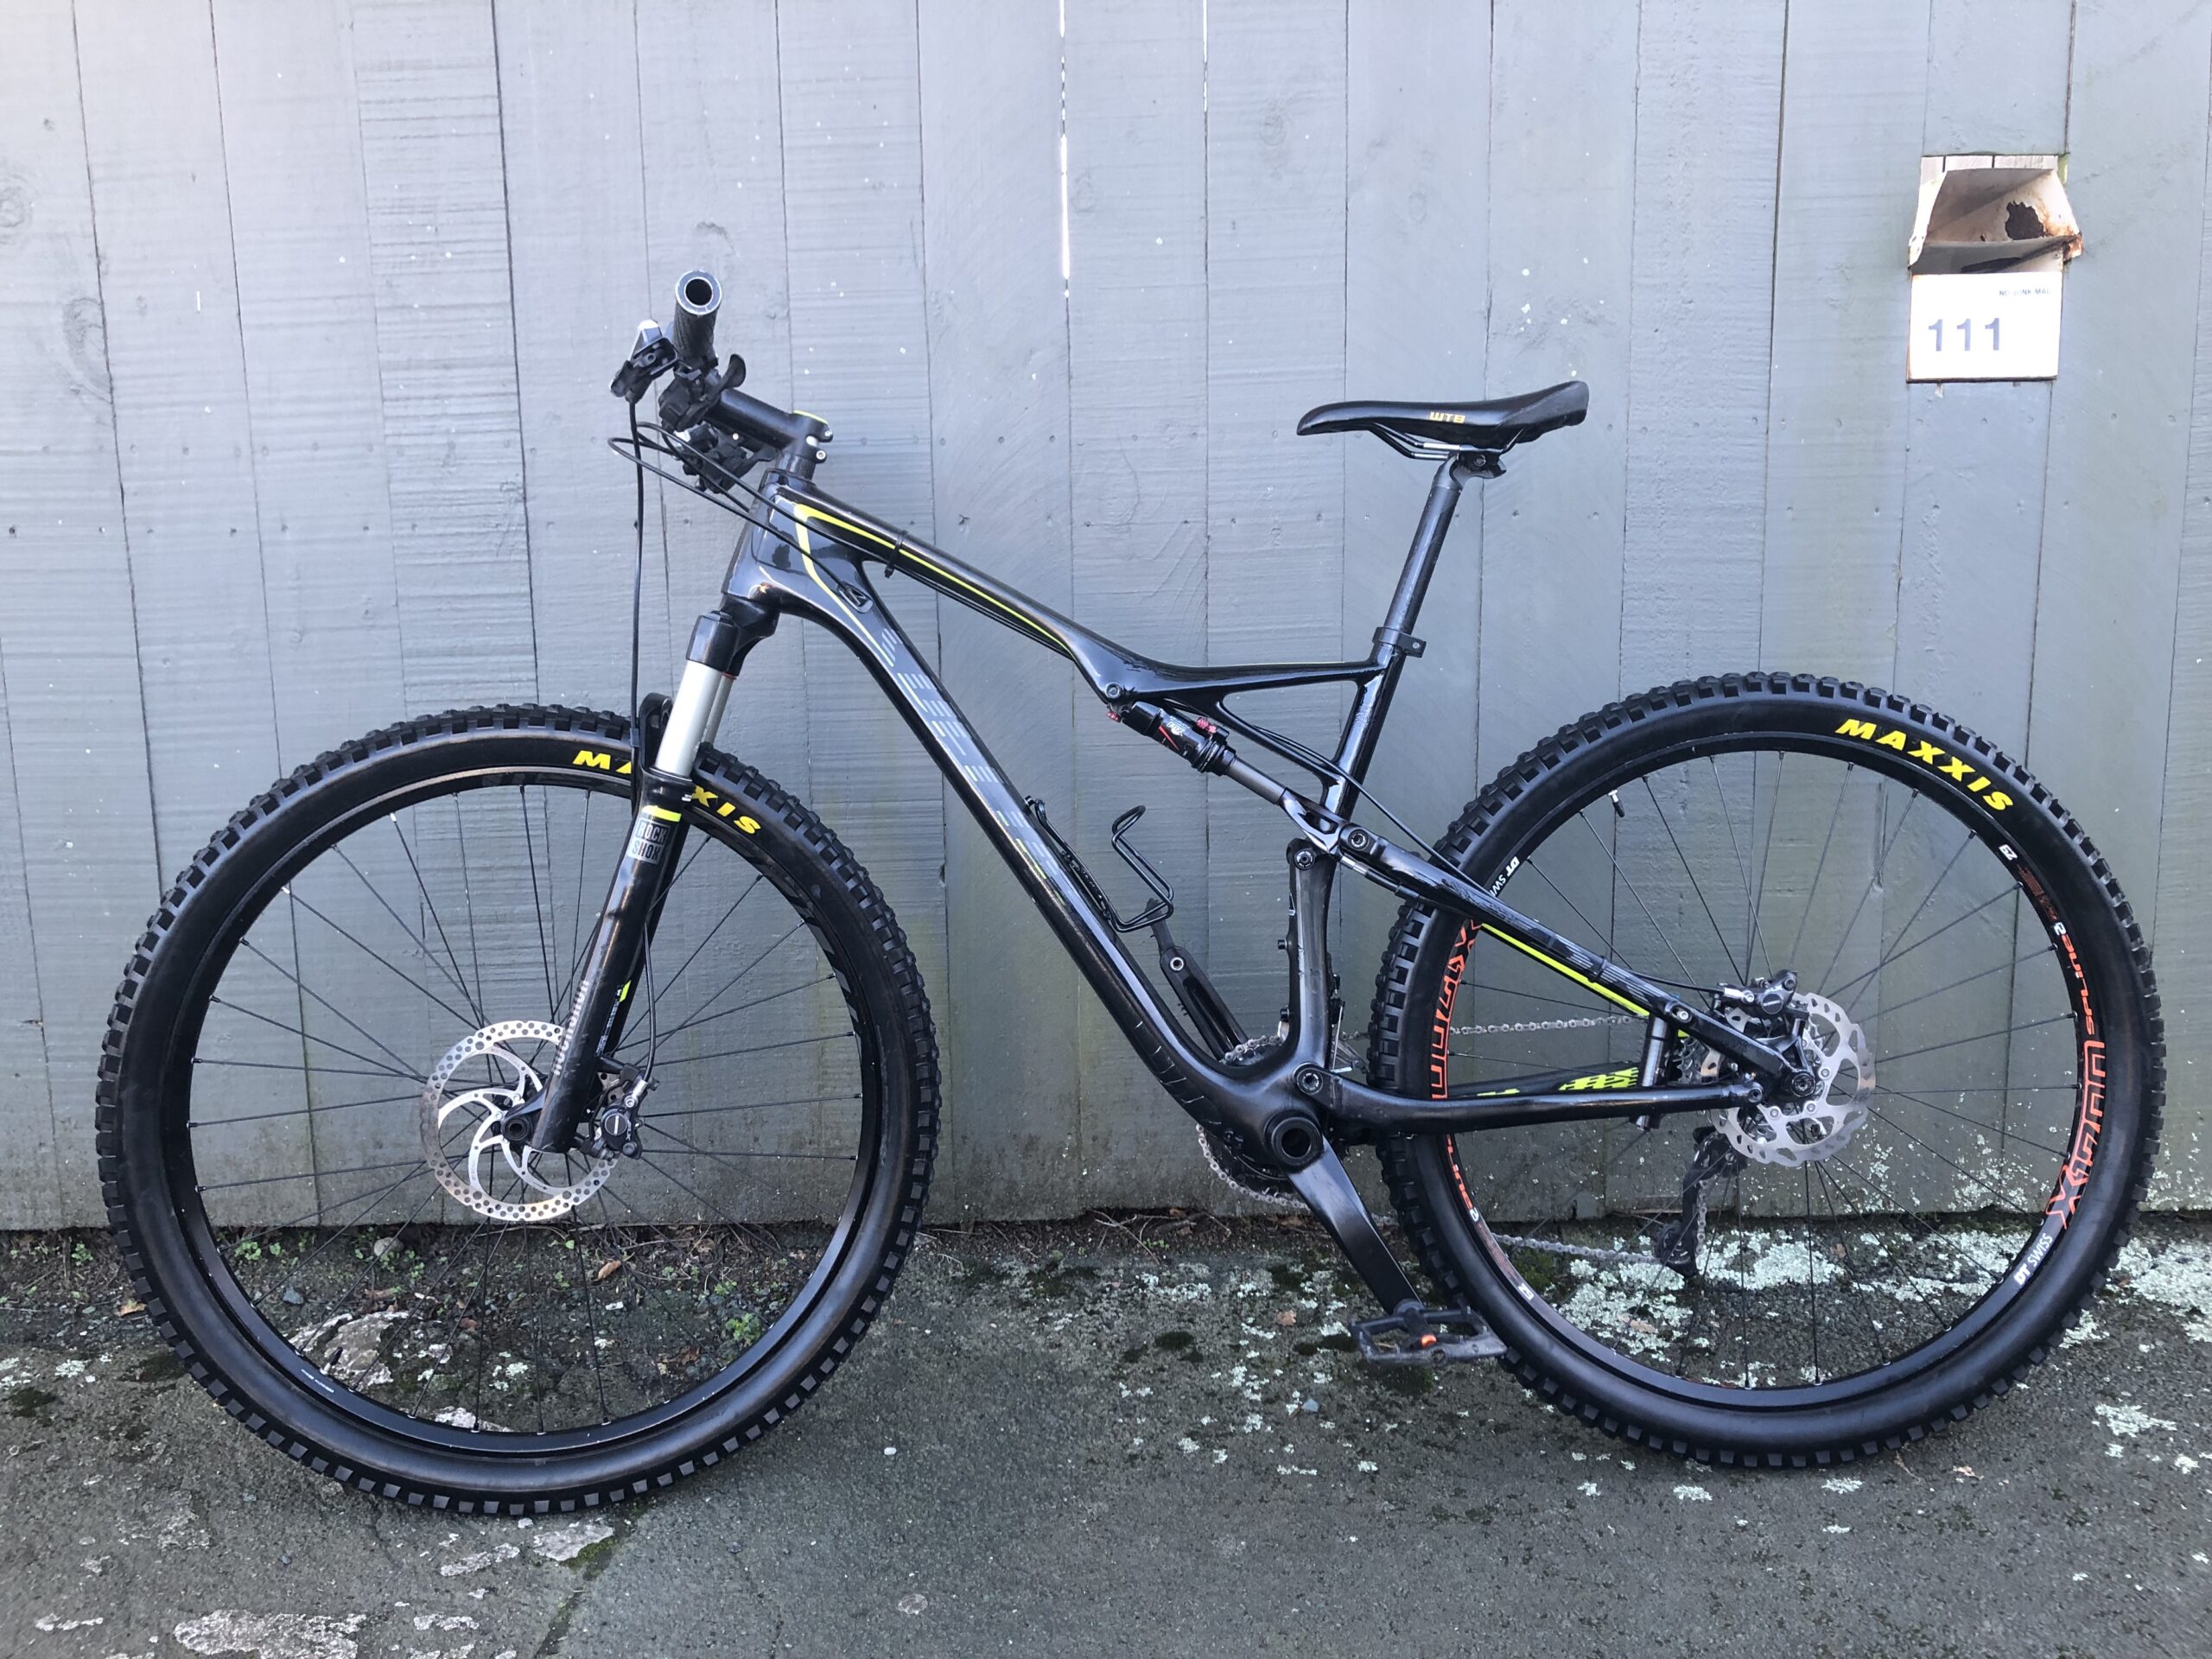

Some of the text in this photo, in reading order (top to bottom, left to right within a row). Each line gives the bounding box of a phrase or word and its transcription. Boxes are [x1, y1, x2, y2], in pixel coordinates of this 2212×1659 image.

[1928, 317, 2000, 352] 111
[1429, 411, 1466, 424] WTB
[1834, 718, 2014, 811] MAXXIS
[637, 818, 669, 842] ROCK
[632, 839, 663, 860] SHOX
[1999, 843, 2018, 861] 29
[1490, 856, 1520, 897] DT SWI
[2014, 1232, 2054, 1287] DT SWISS
